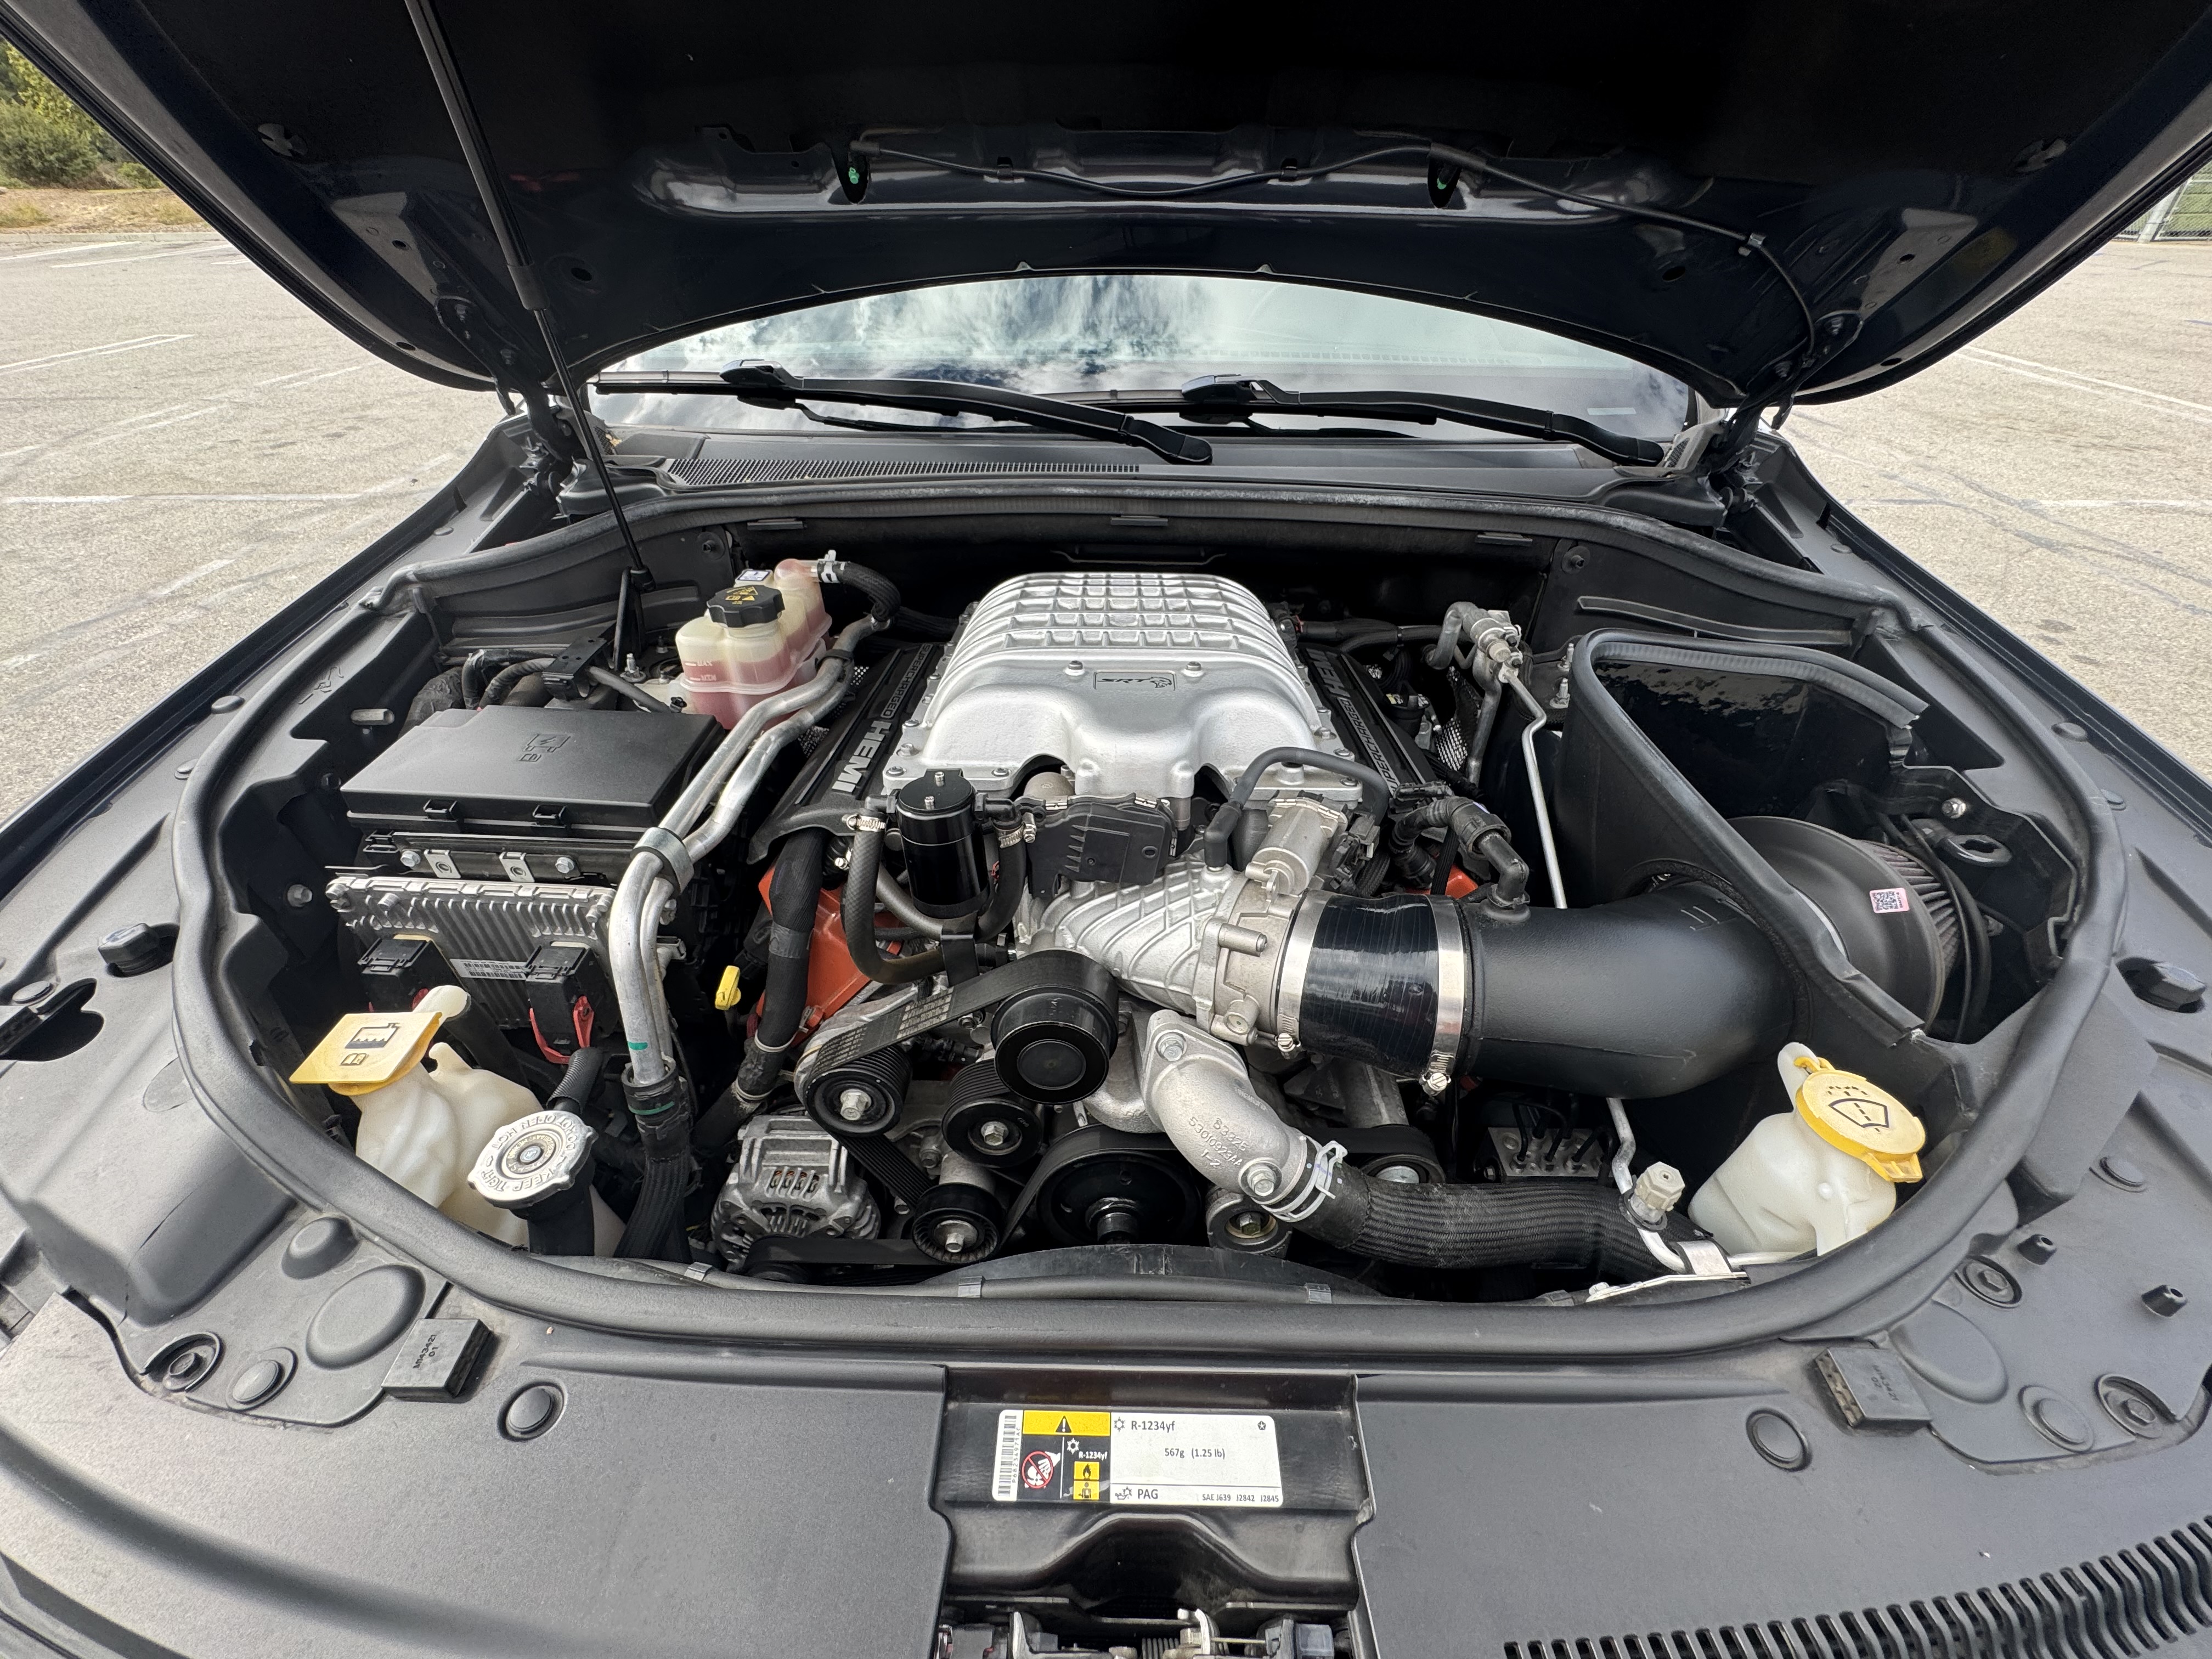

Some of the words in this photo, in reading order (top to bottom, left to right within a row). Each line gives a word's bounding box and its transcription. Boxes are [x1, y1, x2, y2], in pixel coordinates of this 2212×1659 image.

[882, 644, 932, 717] SUPERCHARGED
[1340, 698, 1399, 792] UPERCHARGED
[832, 720, 892, 793] HEMI
[521, 1114, 556, 1130] OPEN
[492, 1127, 517, 1150] HOT
[481, 1169, 507, 1192] TIGHT
[512, 1168, 554, 1192] KEEP
[1131, 1420, 1175, 1433] R-1234yf
[1078, 1451, 1108, 1462] R-1234yf
[1165, 1448, 1185, 1459] 567g
[1191, 1447, 1212, 1459] (1.25
[1214, 1448, 1226, 1460] lb)
[1137, 1488, 1159, 1499] PAG
[1236, 1494, 1255, 1502] J2842
[1260, 1494, 1279, 1503] J2845
